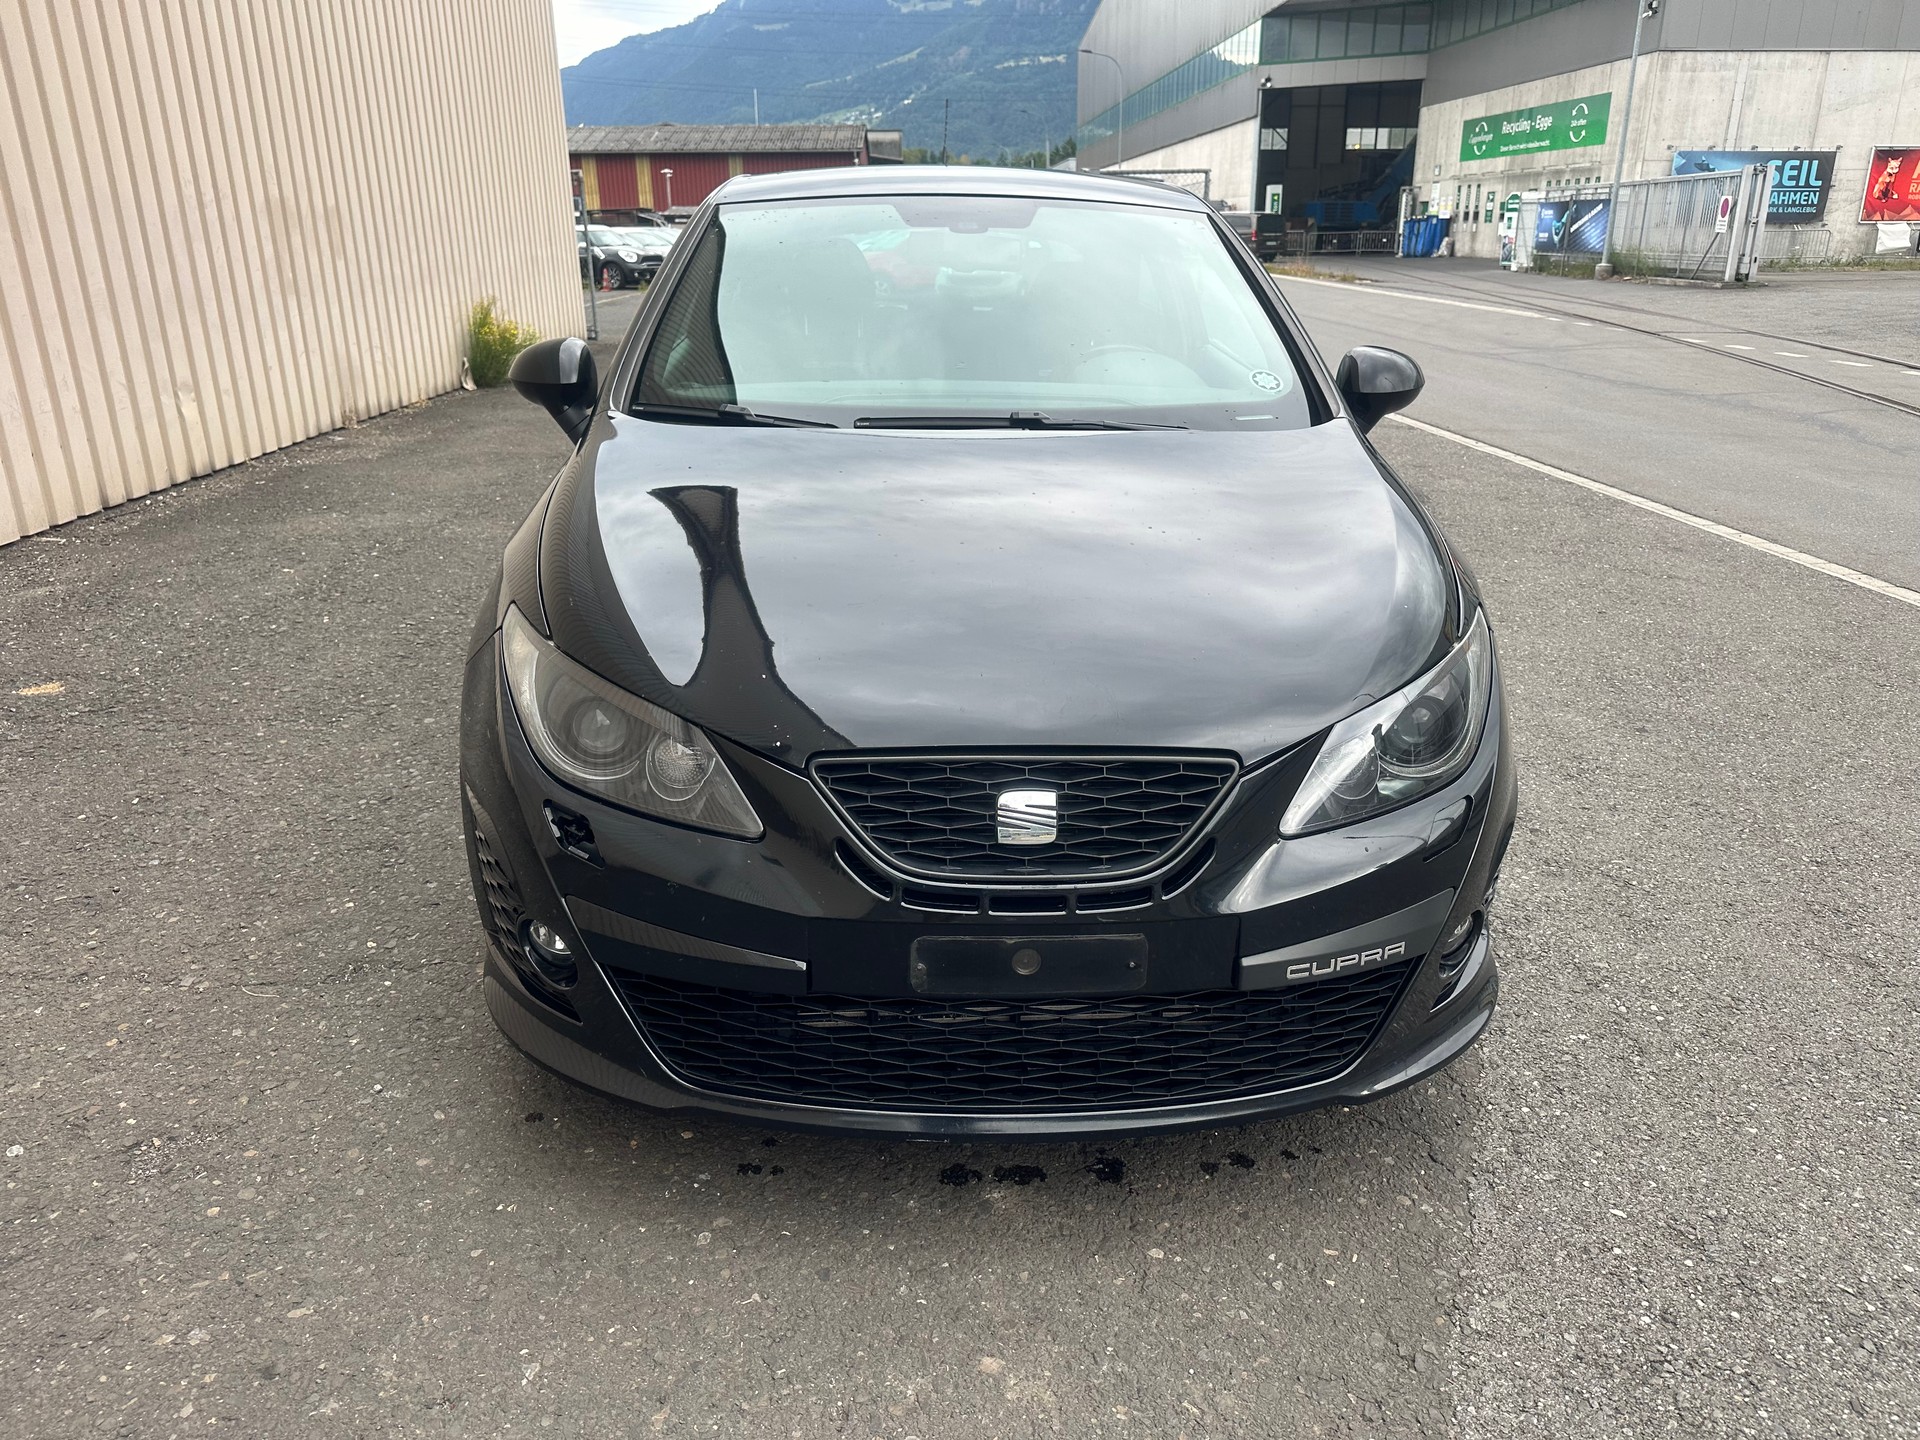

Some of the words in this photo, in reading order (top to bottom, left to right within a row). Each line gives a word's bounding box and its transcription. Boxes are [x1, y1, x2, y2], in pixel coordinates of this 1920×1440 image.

[1501, 118, 1531, 136] Recycling
[1536, 114, 1553, 131] Egge
[1766, 159, 1823, 187] SEIL
[1769, 191, 1820, 205] AHMEN
[1286, 941, 1406, 980] CUPRA
